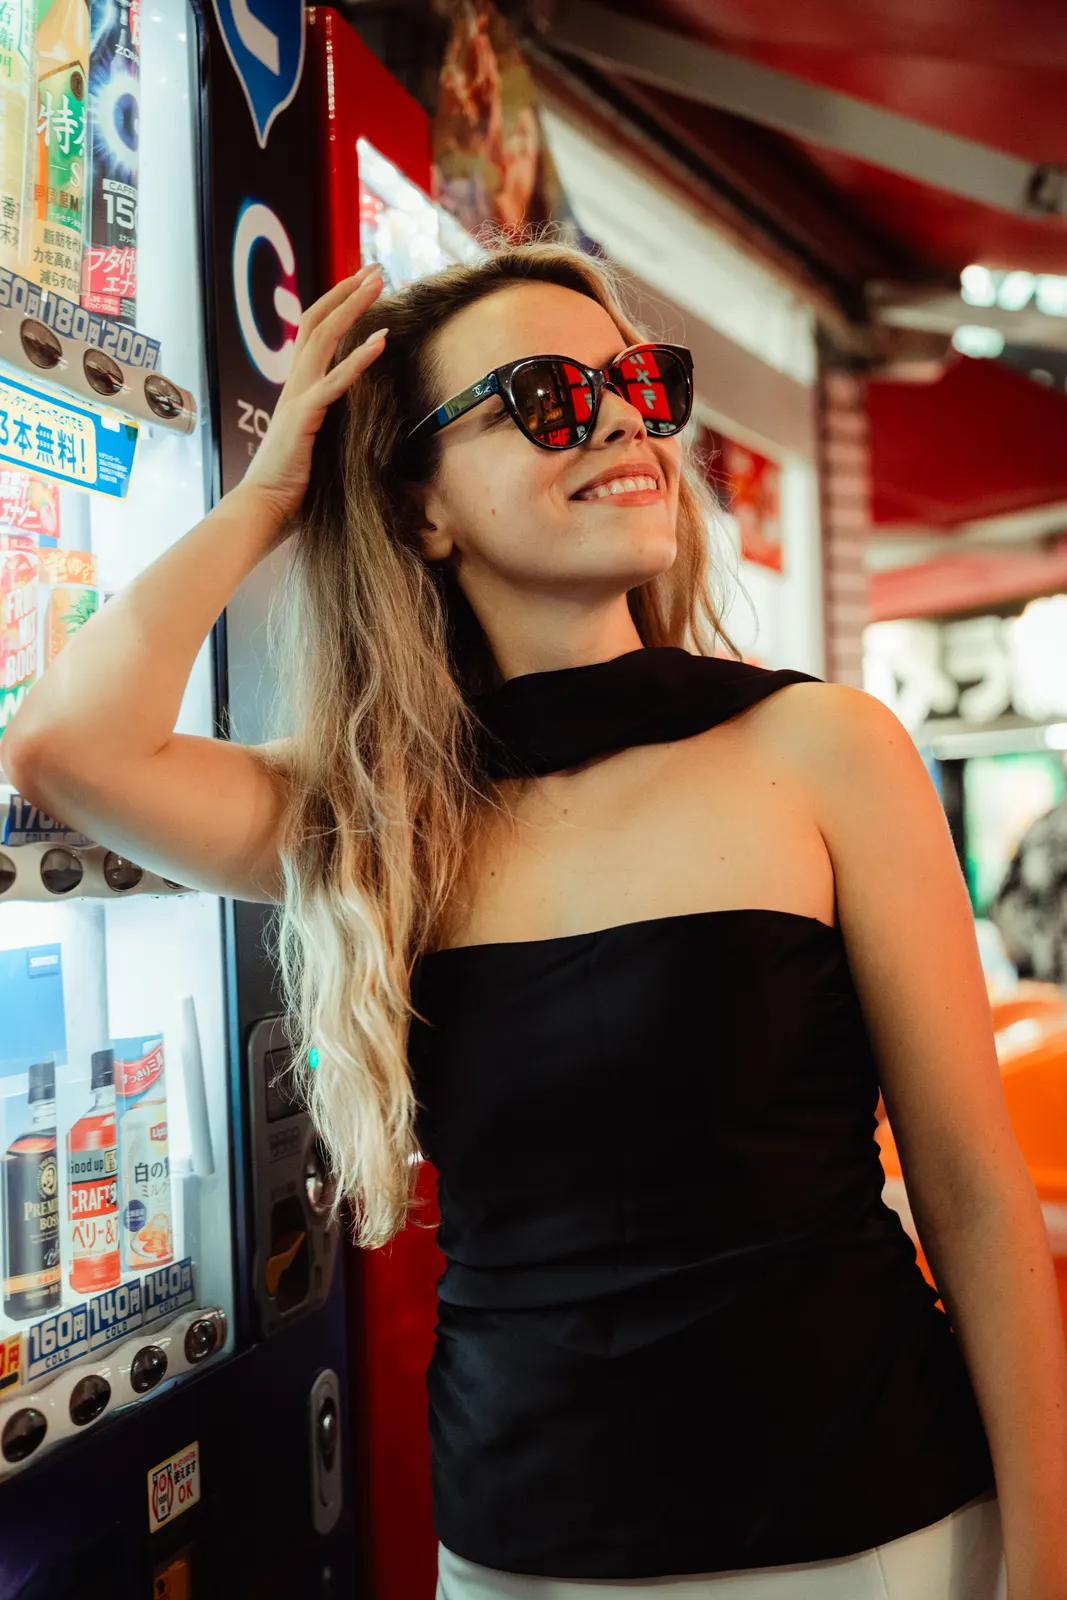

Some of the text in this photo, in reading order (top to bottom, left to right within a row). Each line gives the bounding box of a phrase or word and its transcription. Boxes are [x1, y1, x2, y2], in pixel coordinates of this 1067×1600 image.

[102, 193, 138, 230] 15
[102, 271, 136, 296] エナ
[12, 796, 65, 830] 170
[93, 1159, 104, 1172] up
[70, 1185, 110, 1214] CRAFT
[146, 1264, 191, 1306] 140円
[91, 1286, 141, 1332] 140円
[31, 1311, 87, 1361] 160円
[105, 1320, 128, 1339] COLD
[45, 1349, 70, 1368] COLD
[178, 1478, 194, 1503] OK
